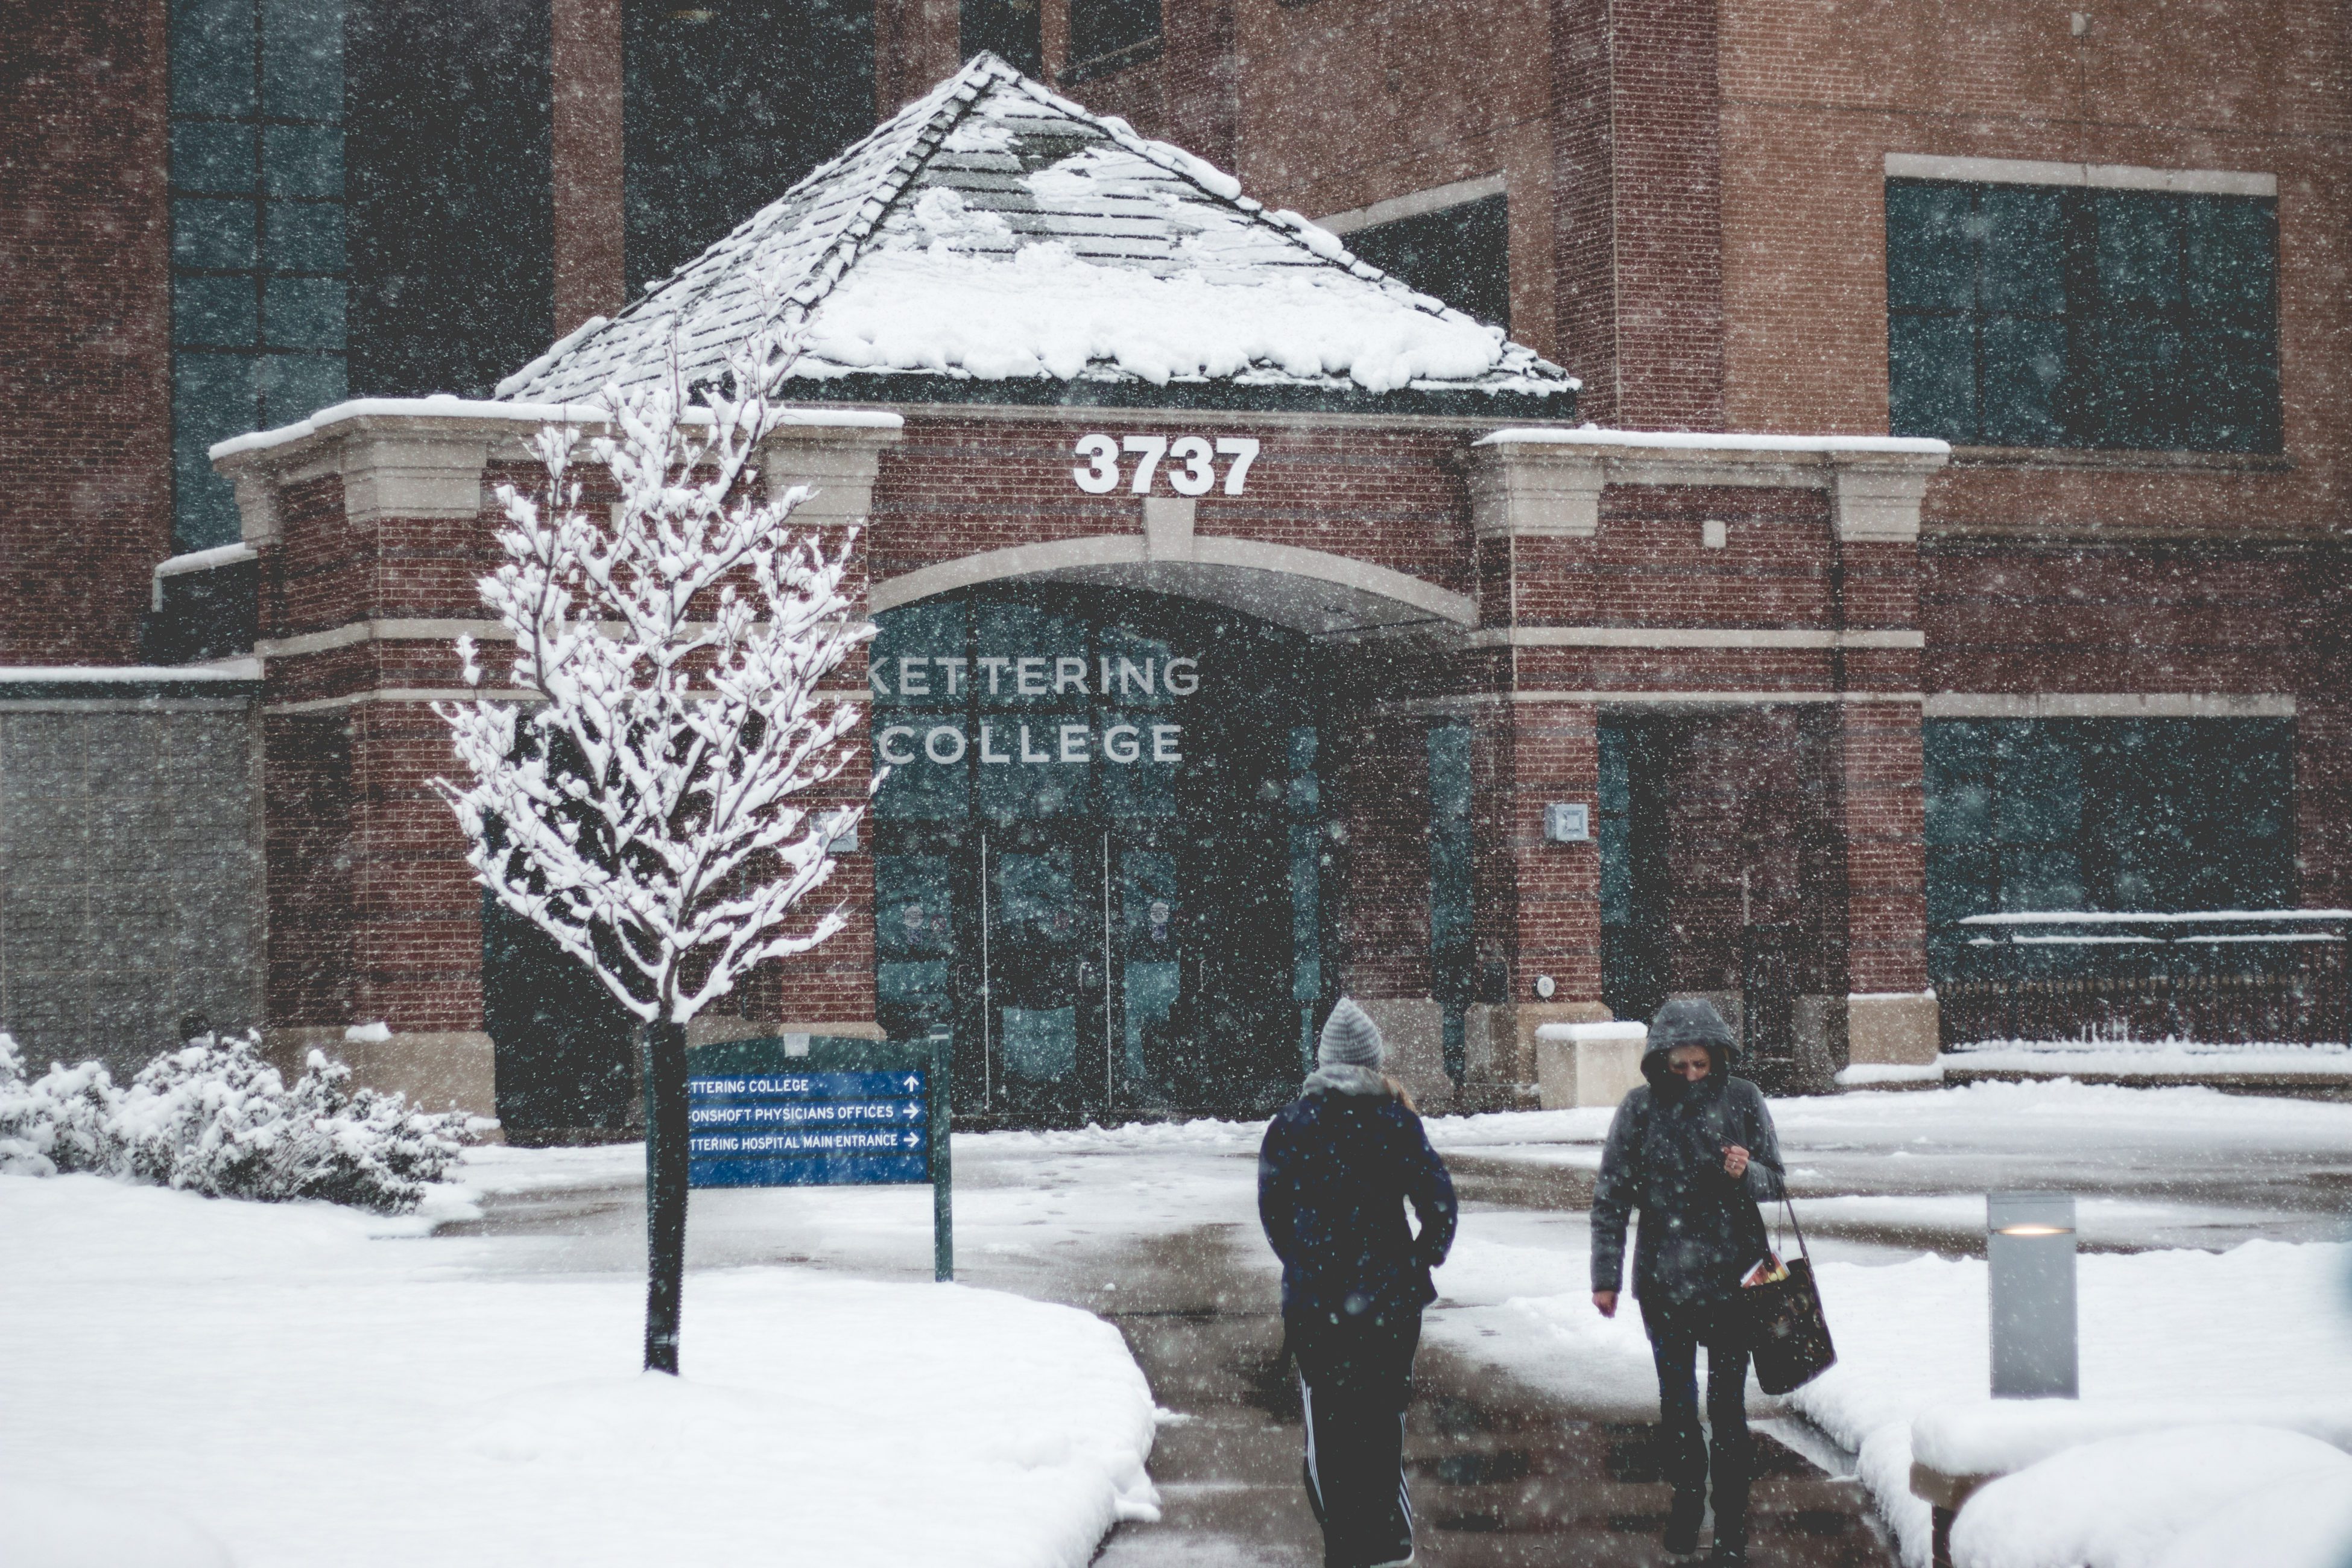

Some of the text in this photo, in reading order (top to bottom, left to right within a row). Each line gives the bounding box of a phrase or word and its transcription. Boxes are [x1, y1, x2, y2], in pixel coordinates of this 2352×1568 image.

[1073, 434, 1259, 495] 3737
[867, 656, 1200, 696] KETTERING
[879, 725, 1183, 765] COLLEGE
[691, 1079, 809, 1093] TTERING COLLEGE
[691, 1105, 894, 1122] ONSHOFT PHYSICIANS OFFICES
[689, 1134, 898, 1151] TTERING HOSPITAL MAIN ENTRANCE
